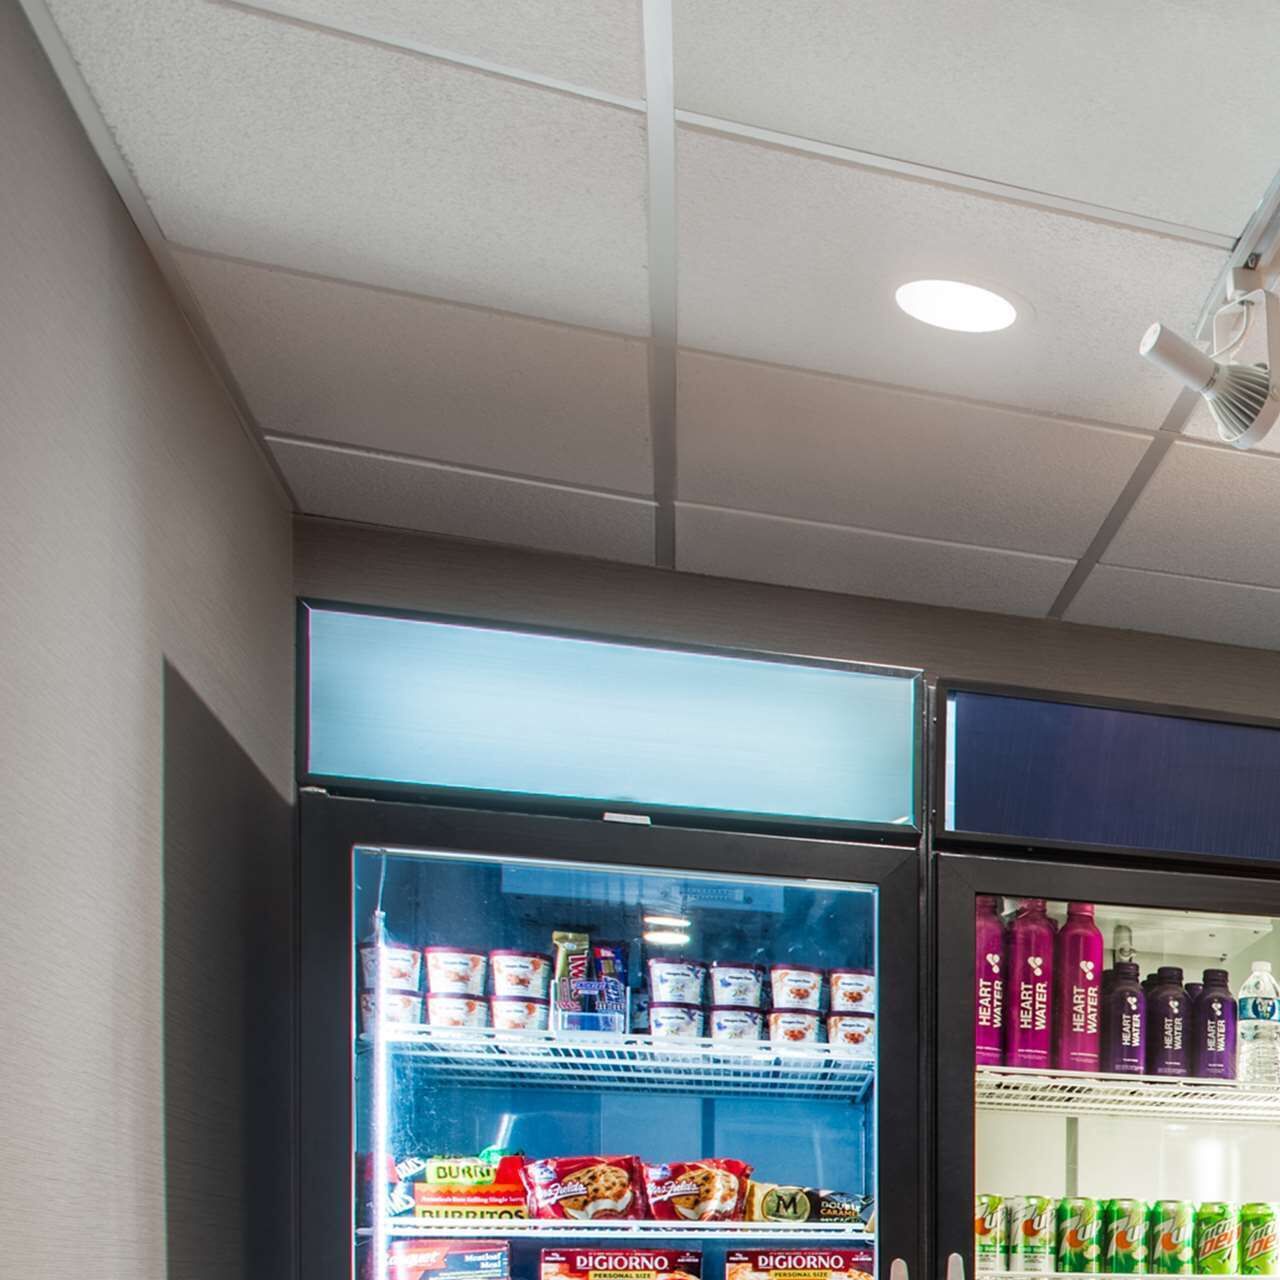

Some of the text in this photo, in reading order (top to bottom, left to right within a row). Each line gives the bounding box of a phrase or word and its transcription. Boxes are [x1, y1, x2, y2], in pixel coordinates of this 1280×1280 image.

[979, 979, 993, 1026] HEART
[993, 980, 1003, 1028] WATER
[1020, 982, 1034, 1029] HEART
[1035, 981, 1048, 1030] WATER
[1072, 985, 1086, 1032] HEART
[1087, 986, 1099, 1034] WATER
[1122, 1014, 1132, 1046] HEART
[1132, 1013, 1141, 1047] WATER
[1164, 1017, 1174, 1049] HEART
[1174, 1017, 1183, 1050] WATER
[1207, 1019, 1216, 1051] HEART
[1217, 1019, 1226, 1052] WATER
[776, 1195, 798, 1214] M
[576, 1255, 668, 1270] DIGIORNO
[758, 1255, 844, 1269] DIGIORNO
